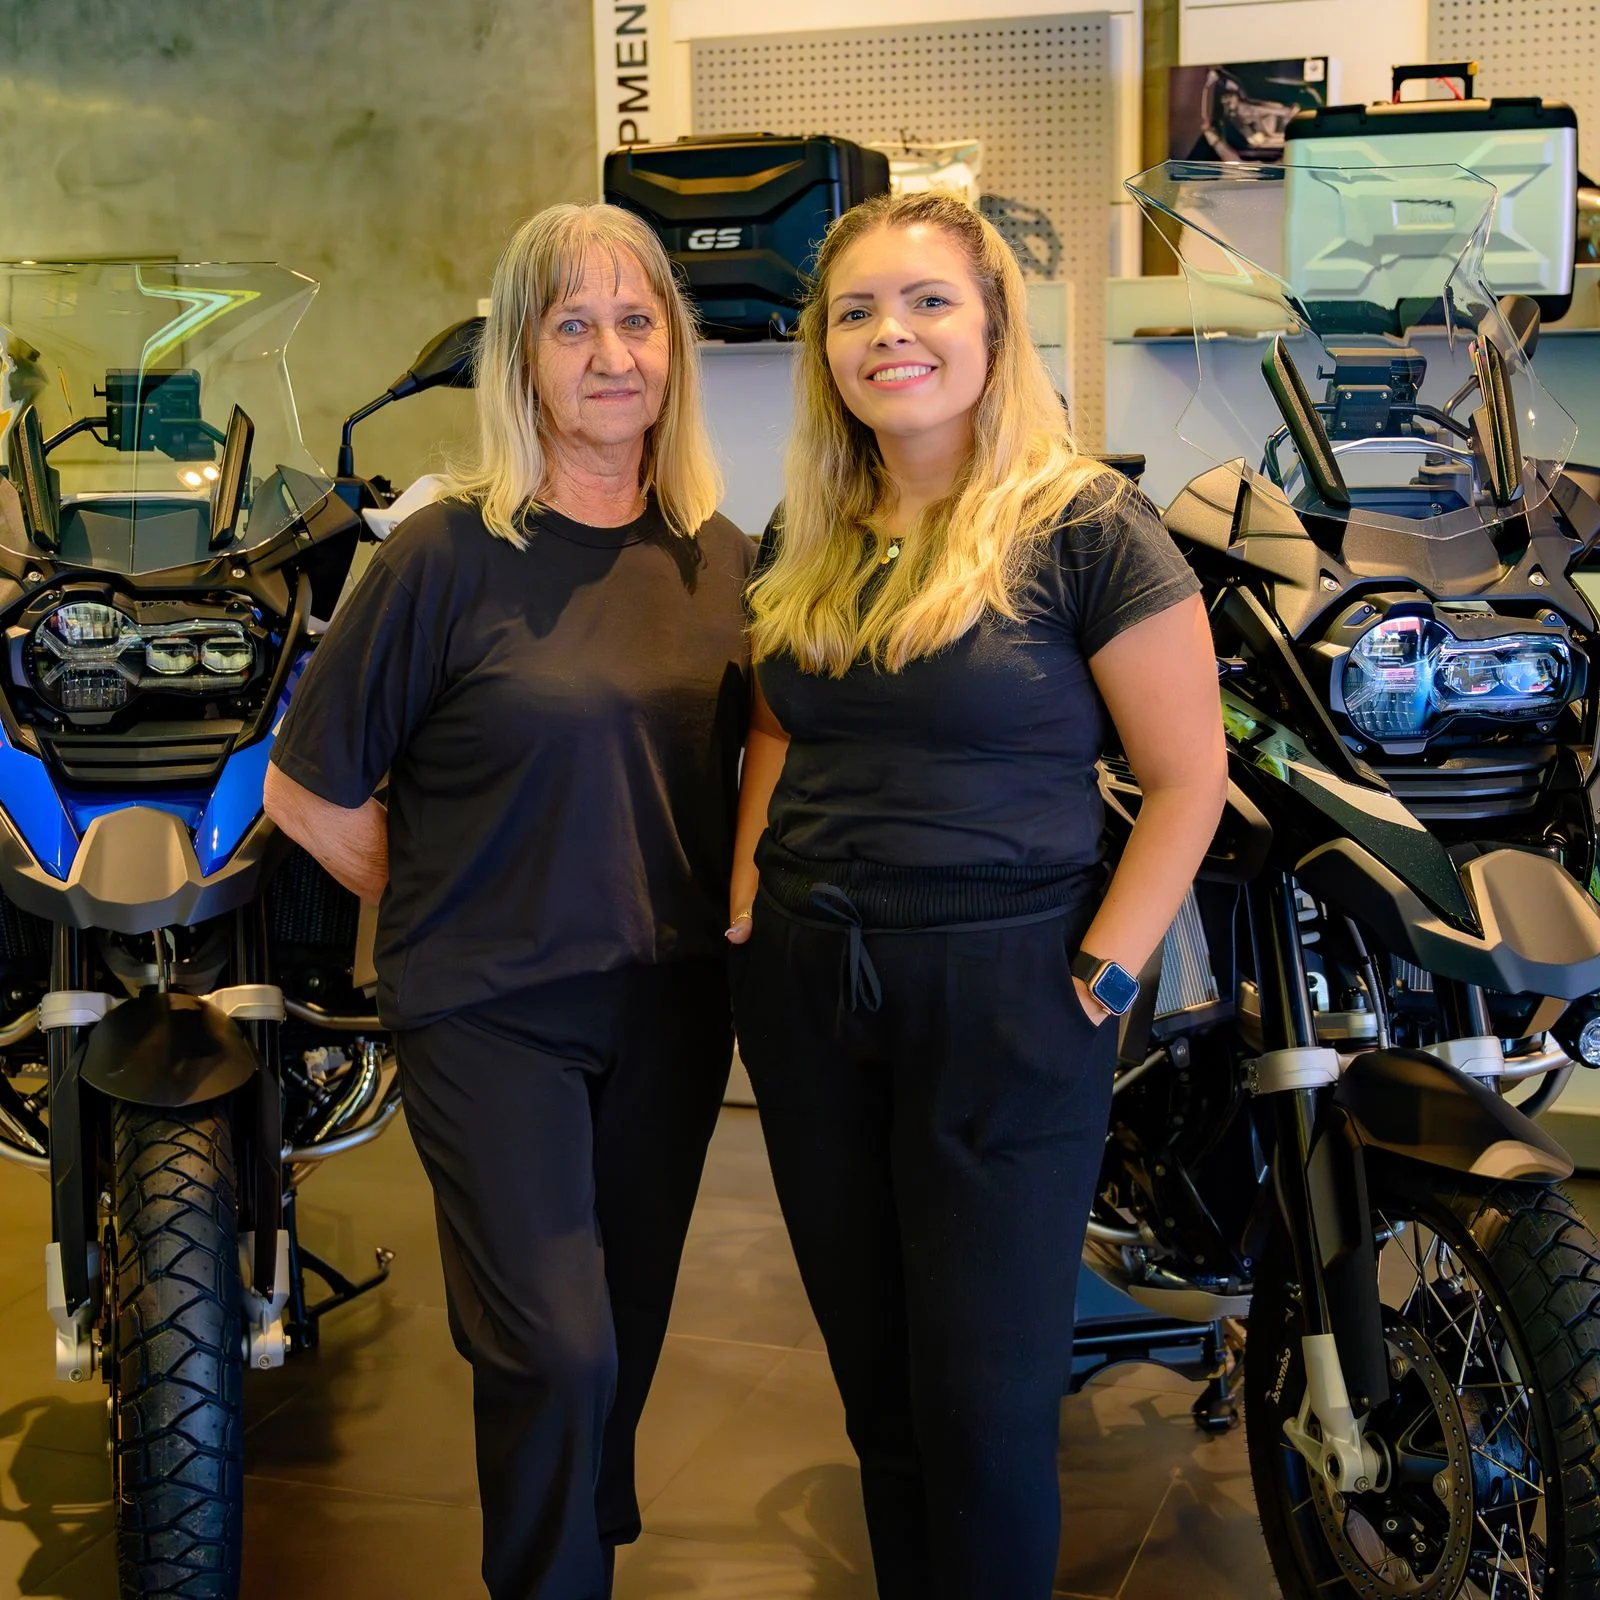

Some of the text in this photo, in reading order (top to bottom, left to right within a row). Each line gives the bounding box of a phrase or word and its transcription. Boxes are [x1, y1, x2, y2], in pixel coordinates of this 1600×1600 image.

[615, 0, 649, 146] PMEN
[688, 227, 742, 250] GS
[1270, 1347, 1291, 1405] brembo
